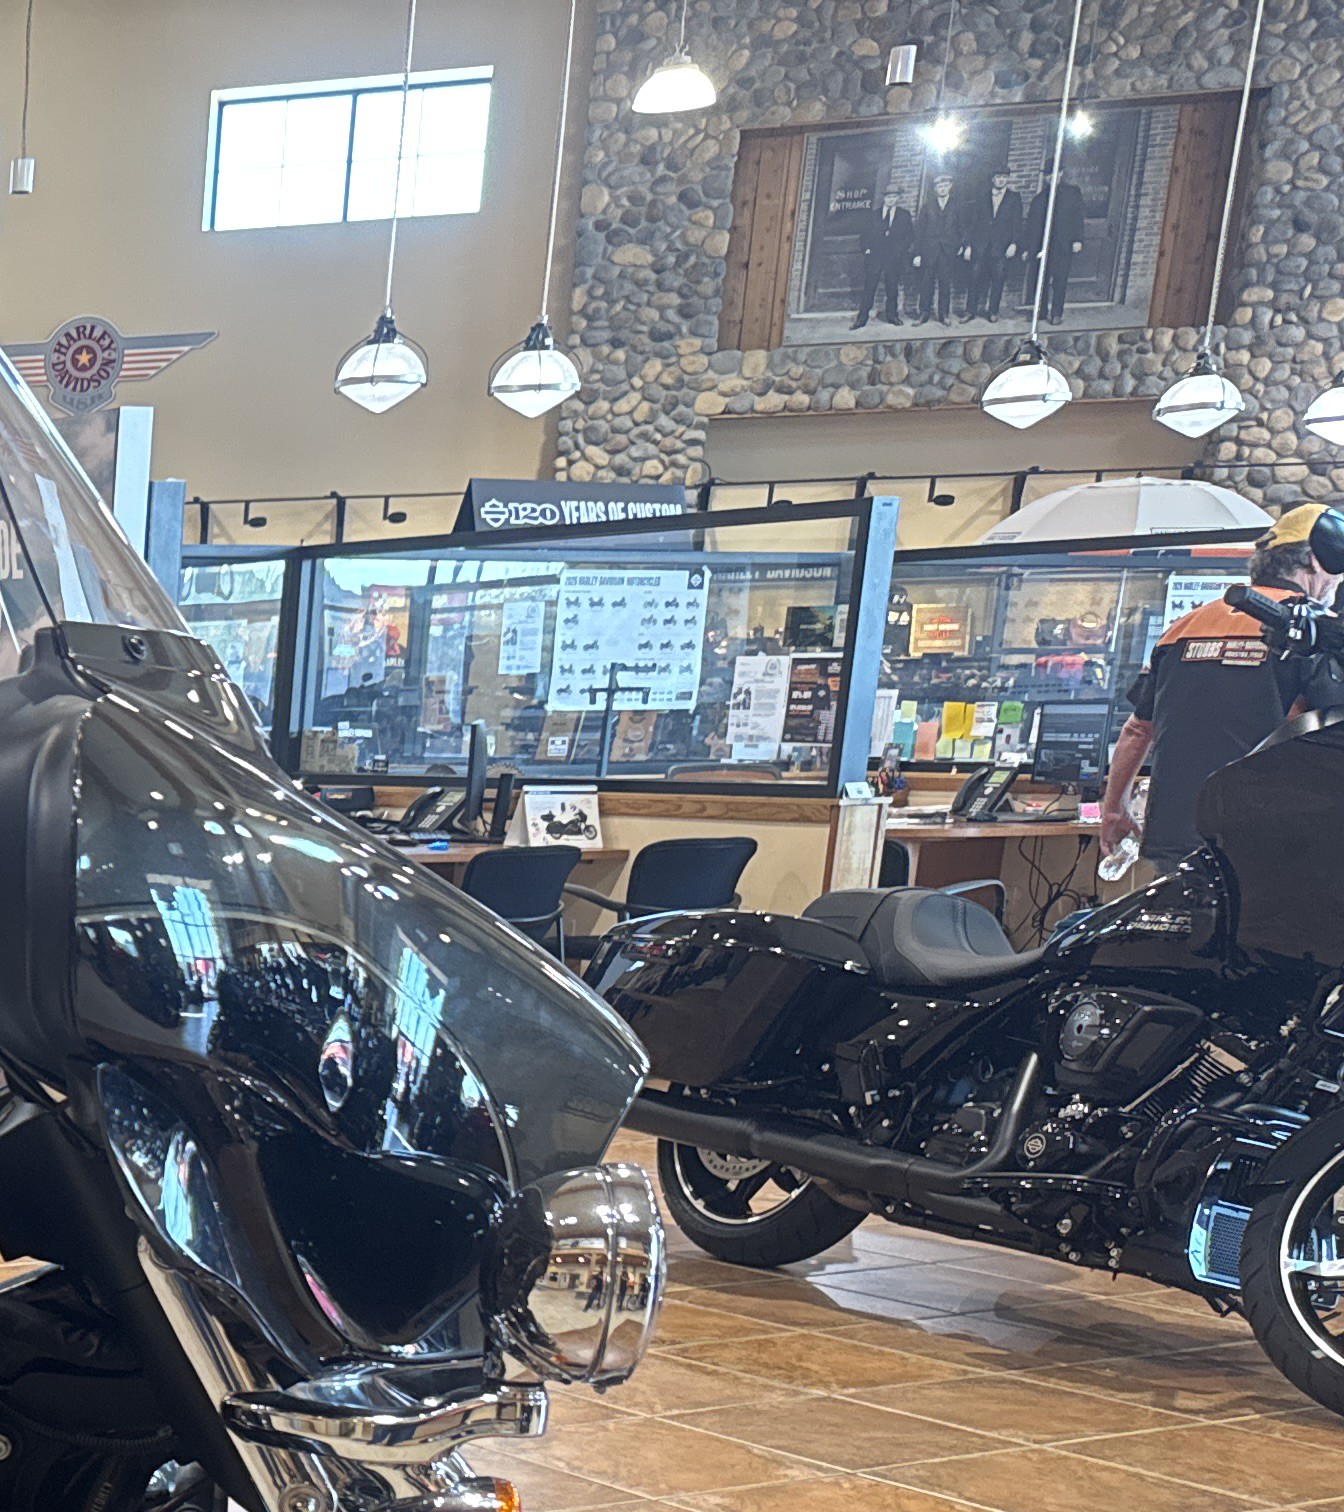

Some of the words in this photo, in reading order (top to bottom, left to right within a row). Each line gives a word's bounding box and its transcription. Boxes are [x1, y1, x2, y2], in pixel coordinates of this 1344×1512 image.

[829, 199, 872, 212] ENTRANCE
[836, 188, 868, 199] SHOP
[53, 323, 117, 357] HARLEY
[51, 358, 117, 393] DAVIDSON
[508, 501, 560, 525] 120
[561, 500, 607, 525] YEARS
[608, 501, 626, 521] OF
